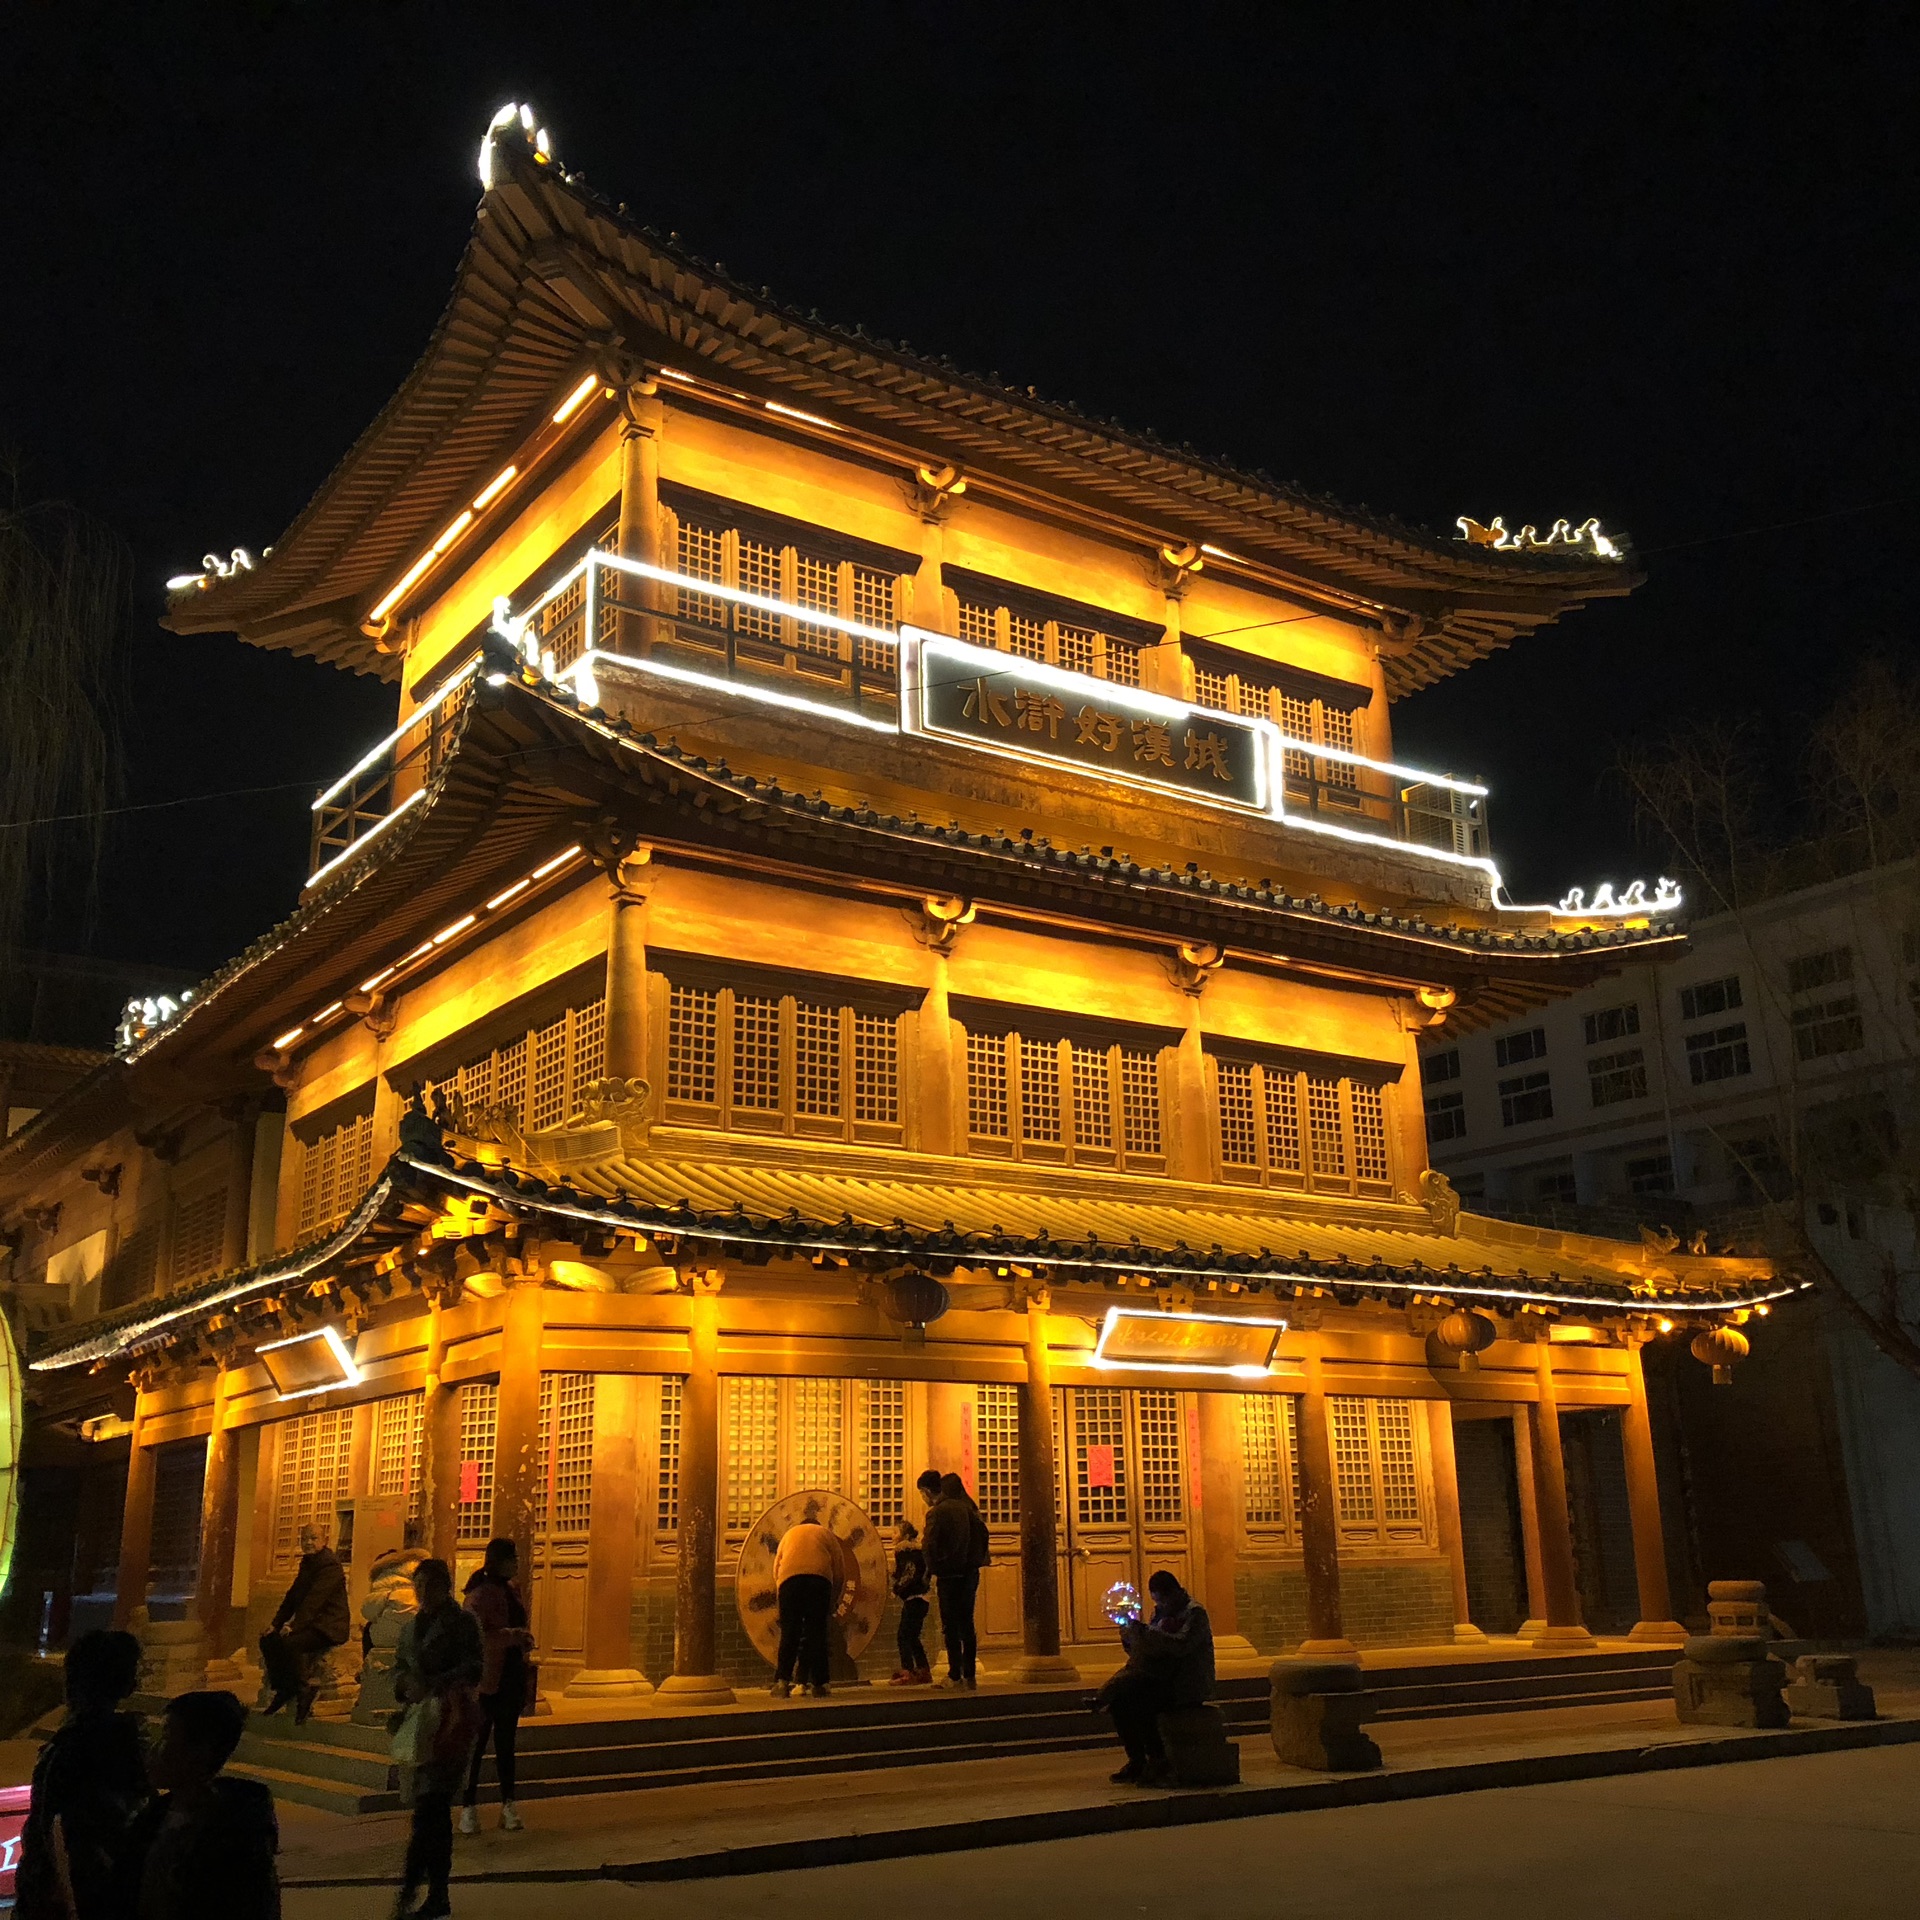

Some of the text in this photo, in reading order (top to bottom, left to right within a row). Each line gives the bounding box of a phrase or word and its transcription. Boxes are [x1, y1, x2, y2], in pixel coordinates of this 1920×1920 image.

[956, 677, 1233, 782] 水滸好漢城
